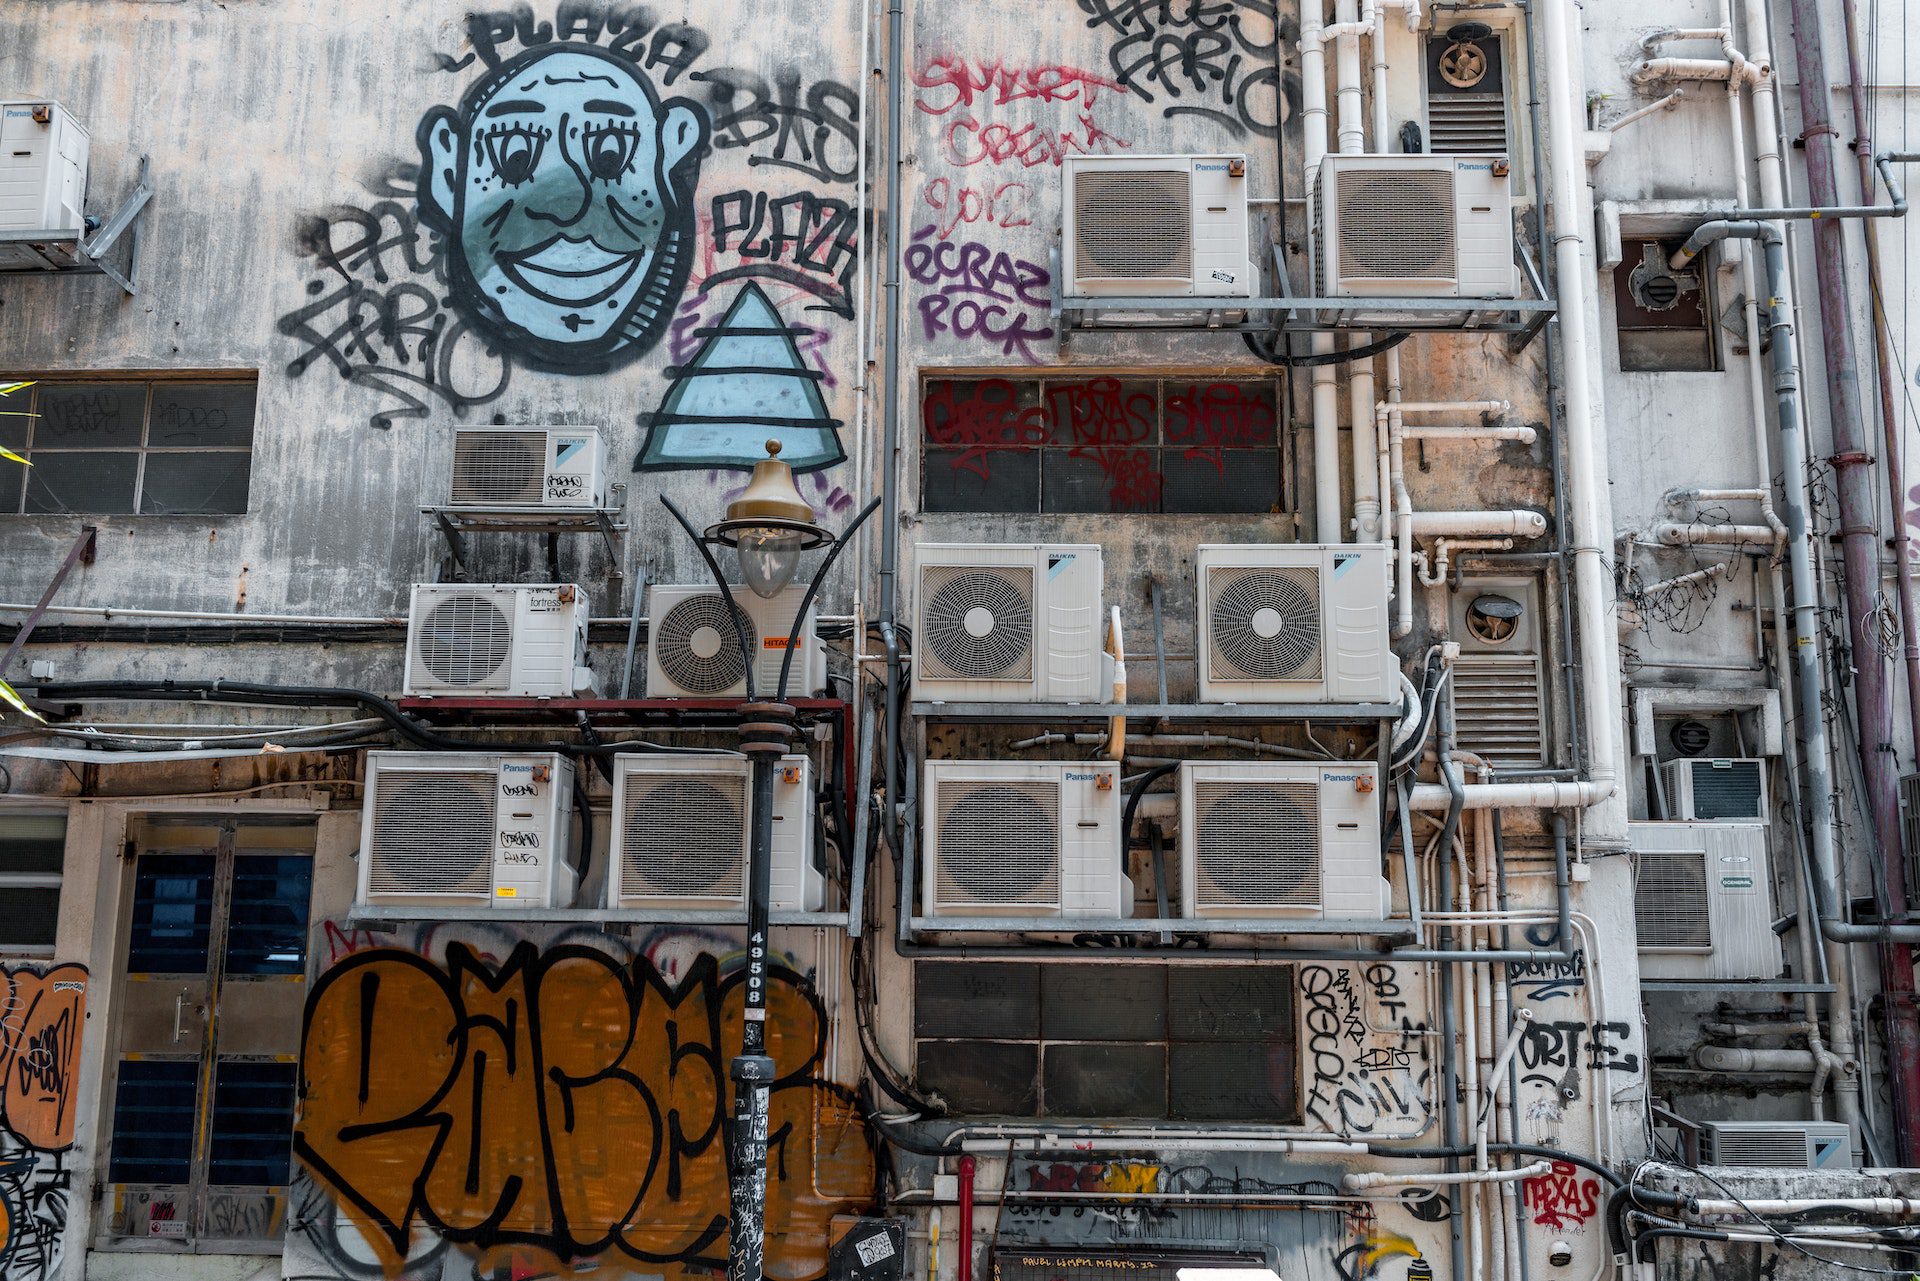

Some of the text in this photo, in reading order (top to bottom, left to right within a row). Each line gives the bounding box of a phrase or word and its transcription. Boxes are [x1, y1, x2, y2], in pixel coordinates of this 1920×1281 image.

[464, 0, 710, 86] PLAZA
[1457, 162, 1493, 170] Panaso
[918, 294, 1054, 364] ROCK
[530, 597, 562, 607] fortress
[749, 931, 765, 1003] 49508
